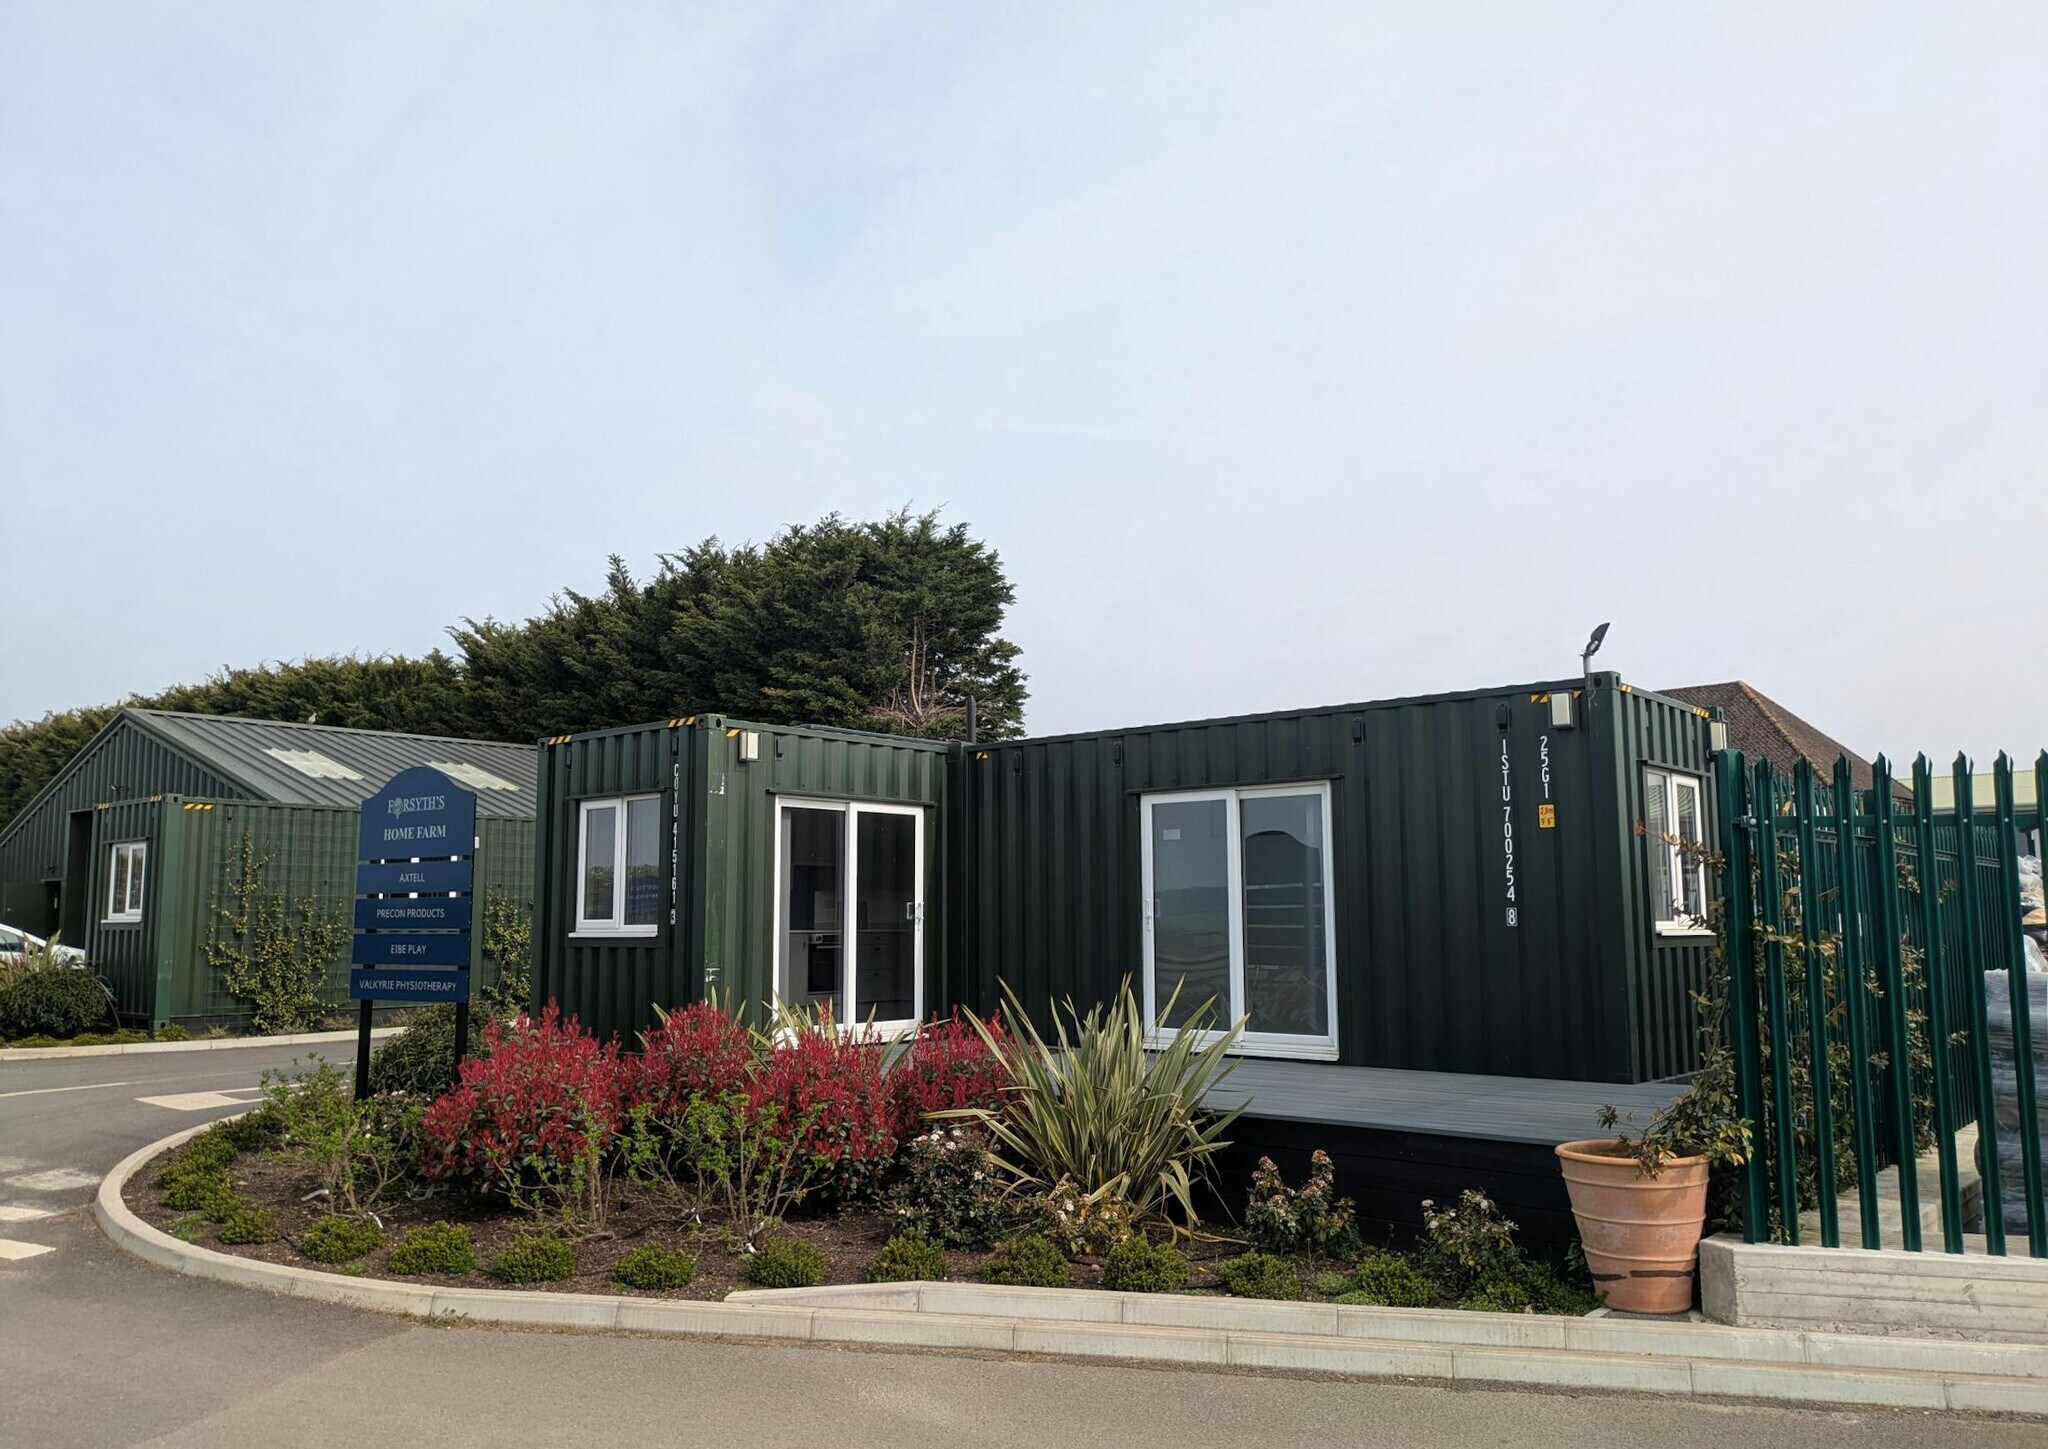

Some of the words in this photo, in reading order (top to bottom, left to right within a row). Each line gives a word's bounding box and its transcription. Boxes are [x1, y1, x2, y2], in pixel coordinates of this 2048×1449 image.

[1501, 738, 1511, 801] ISTU
[1540, 735, 1550, 799] 25G1
[383, 827, 415, 841] HOME
[417, 825, 446, 839] FARM
[1503, 806, 1516, 902] 700254
[399, 873, 425, 883] AXTELL
[376, 908, 406, 918] PRECON
[406, 908, 445, 918] PRODUCTS
[1507, 908, 1517, 926] 8
[390, 944, 407, 954] EIBE
[408, 944, 427, 954] PLAY
[359, 980, 394, 989] VALKYRIE
[396, 980, 457, 991] PHYSIOTHERAPY
